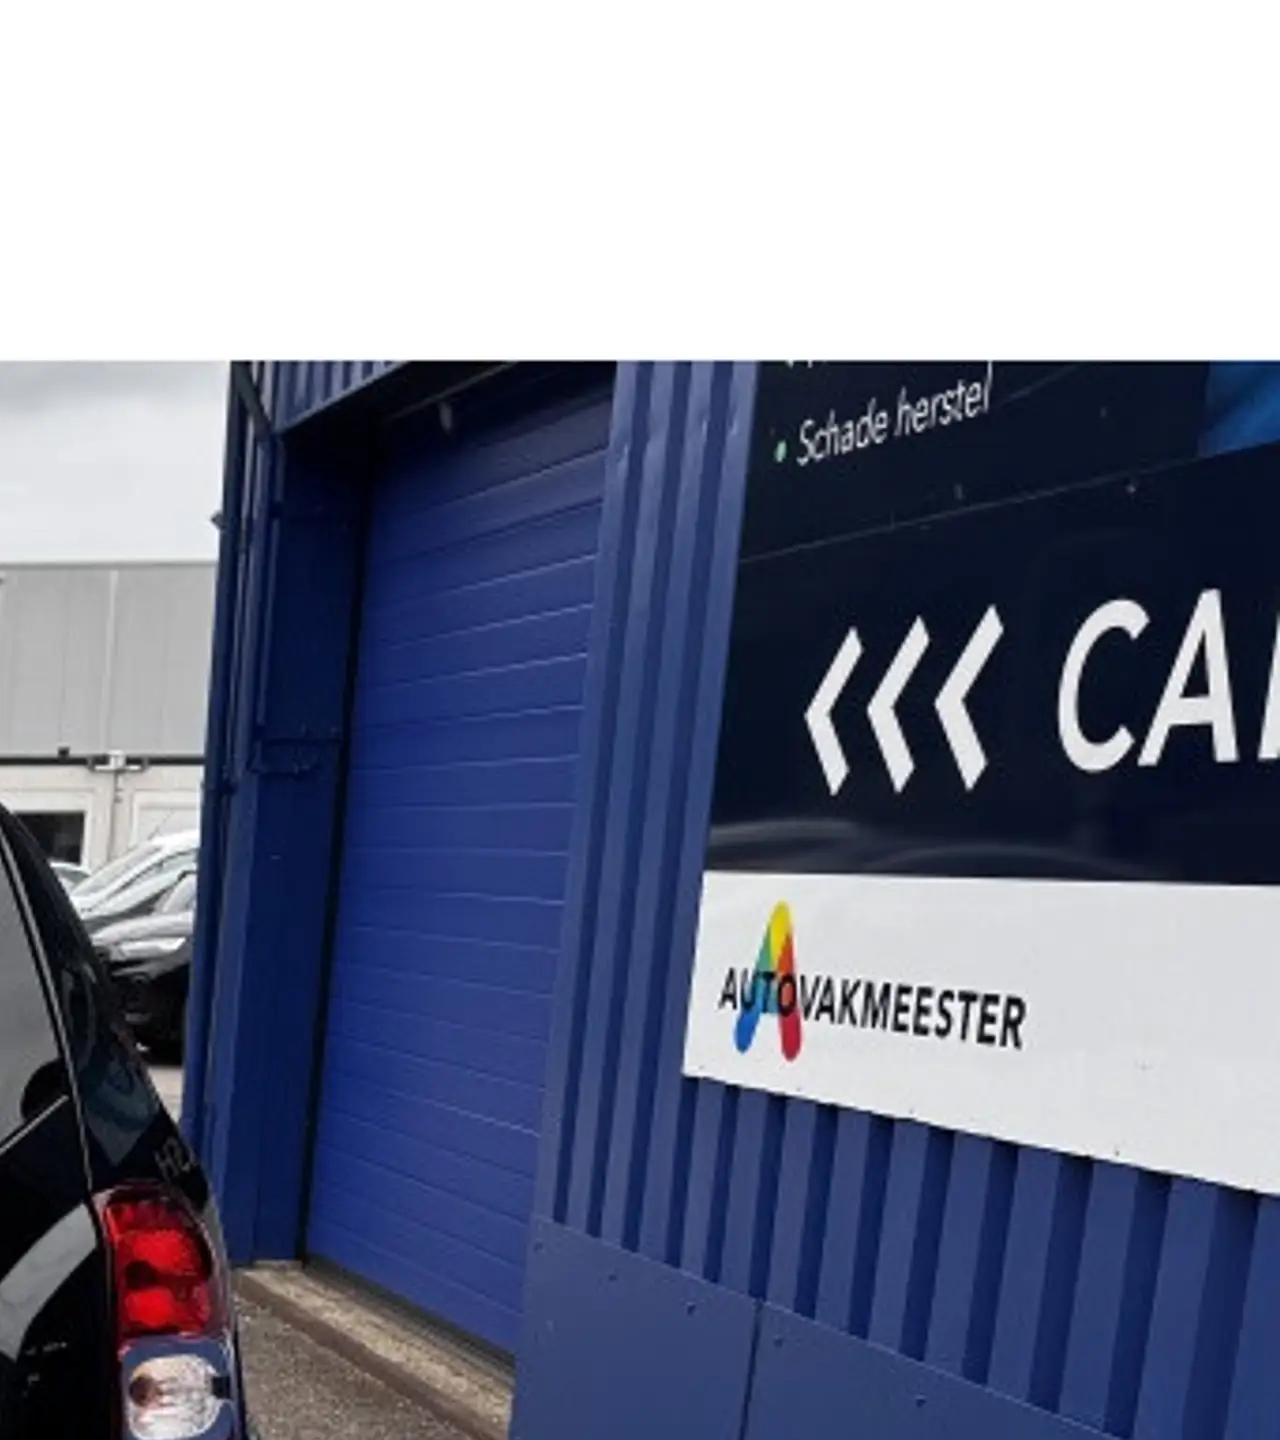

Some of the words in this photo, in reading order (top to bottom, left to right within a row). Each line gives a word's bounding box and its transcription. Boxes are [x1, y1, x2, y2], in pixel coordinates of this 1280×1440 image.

[796, 397, 889, 466] Schade
[894, 361, 993, 436] herstel
[1058, 588, 1280, 772] CA
[718, 967, 1027, 1050] AUTOVAKMEESTER
